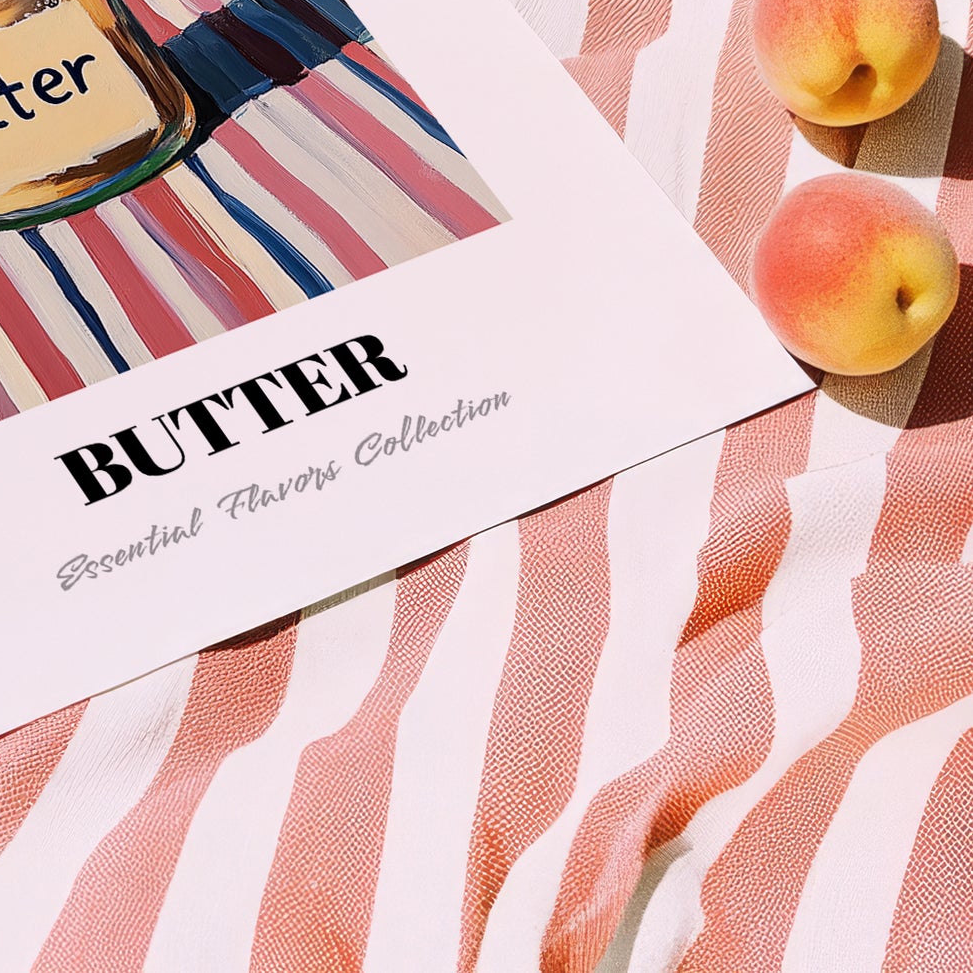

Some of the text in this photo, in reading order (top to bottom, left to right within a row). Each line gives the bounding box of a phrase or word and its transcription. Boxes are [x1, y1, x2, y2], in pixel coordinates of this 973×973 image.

[53, 334, 408, 506] BUTTER
[56, 390, 513, 591] Essential Flavors Collection
